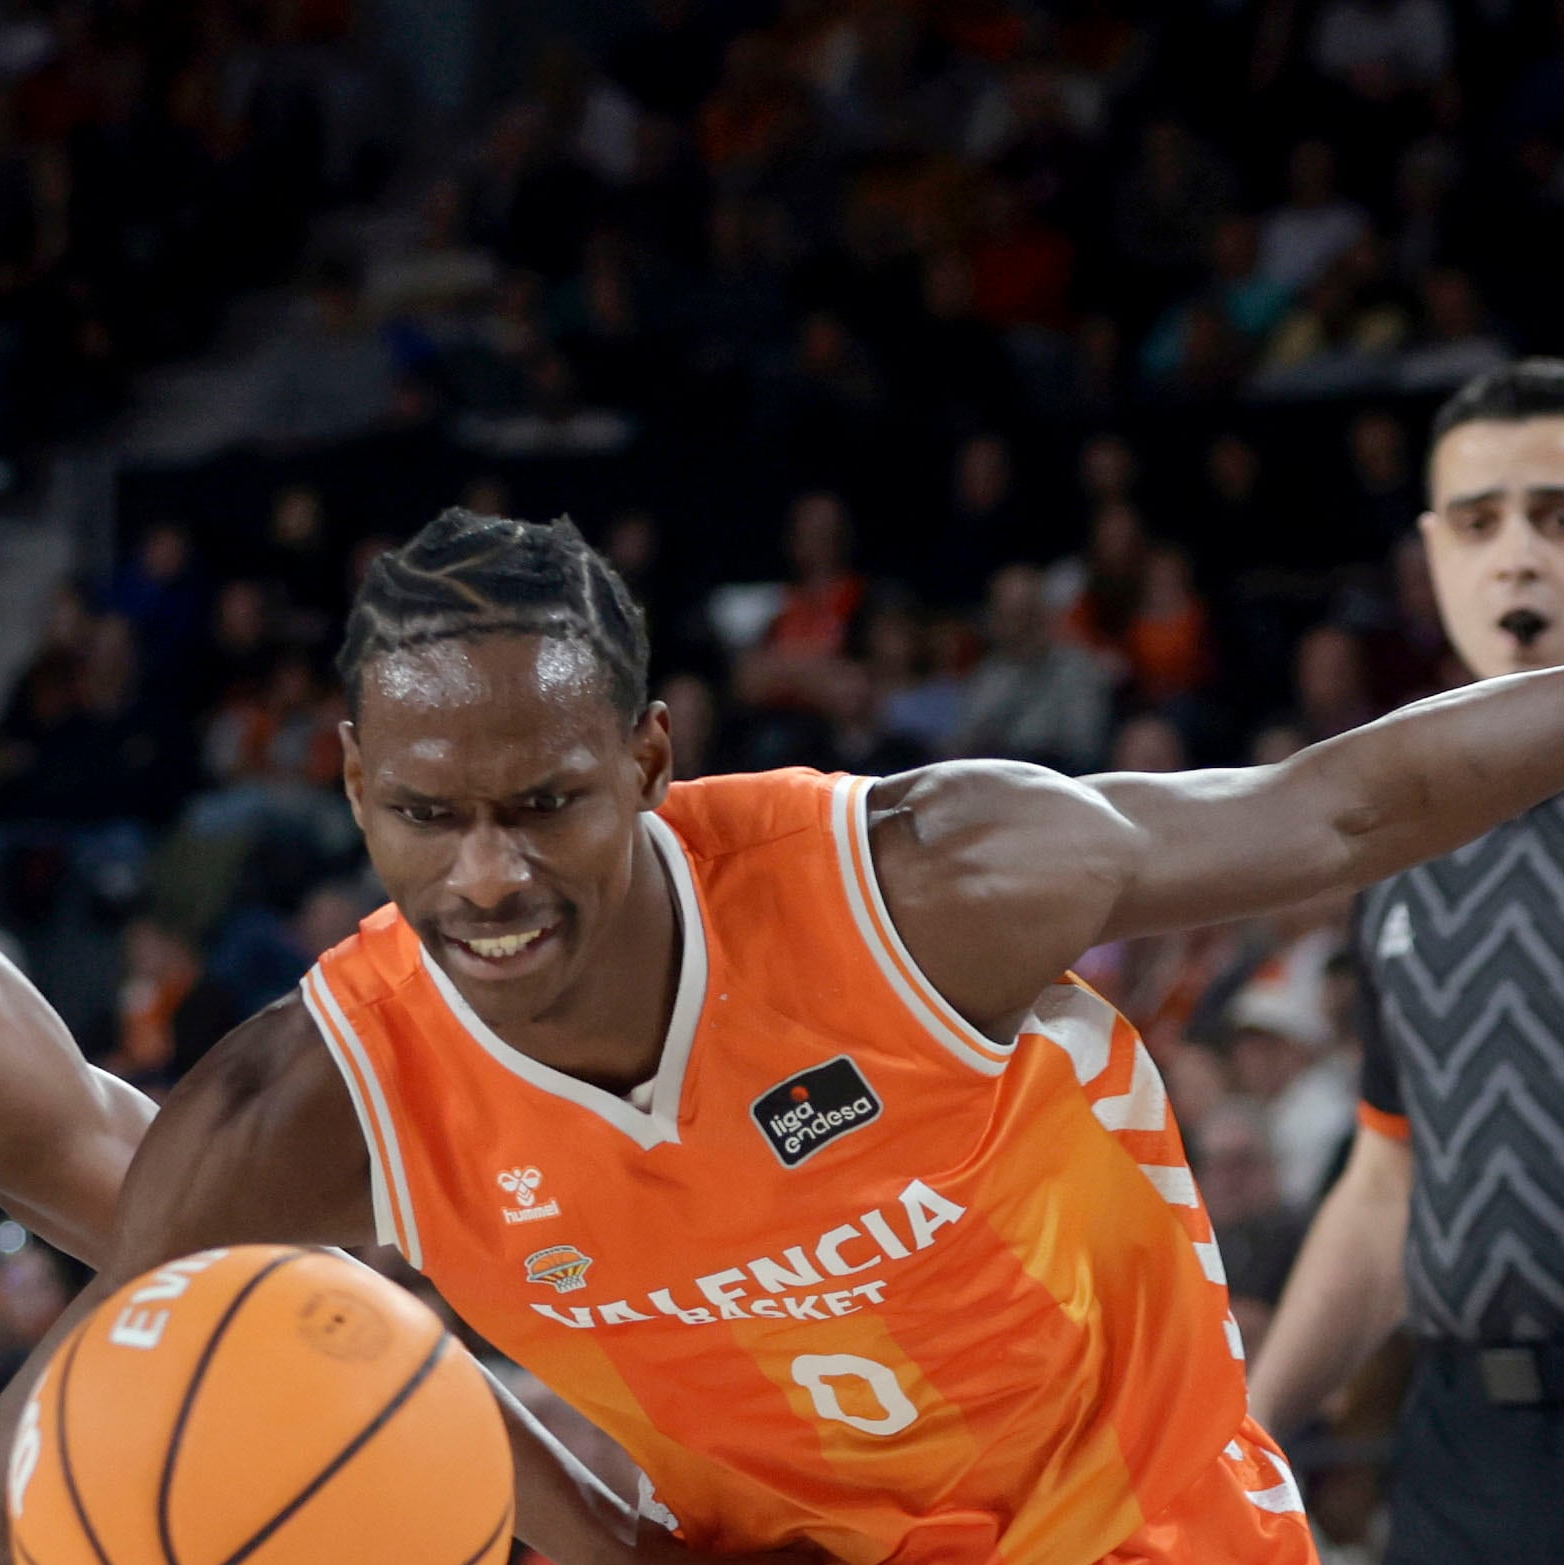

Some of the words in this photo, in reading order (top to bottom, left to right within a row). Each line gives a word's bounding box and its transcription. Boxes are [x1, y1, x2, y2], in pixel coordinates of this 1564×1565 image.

[769, 1101, 815, 1137] liga
[784, 1097, 873, 1154] endesa
[529, 1179, 967, 1329] VALENCIA
[677, 1279, 888, 1325] BASKET
[791, 1354, 919, 1436] 0
